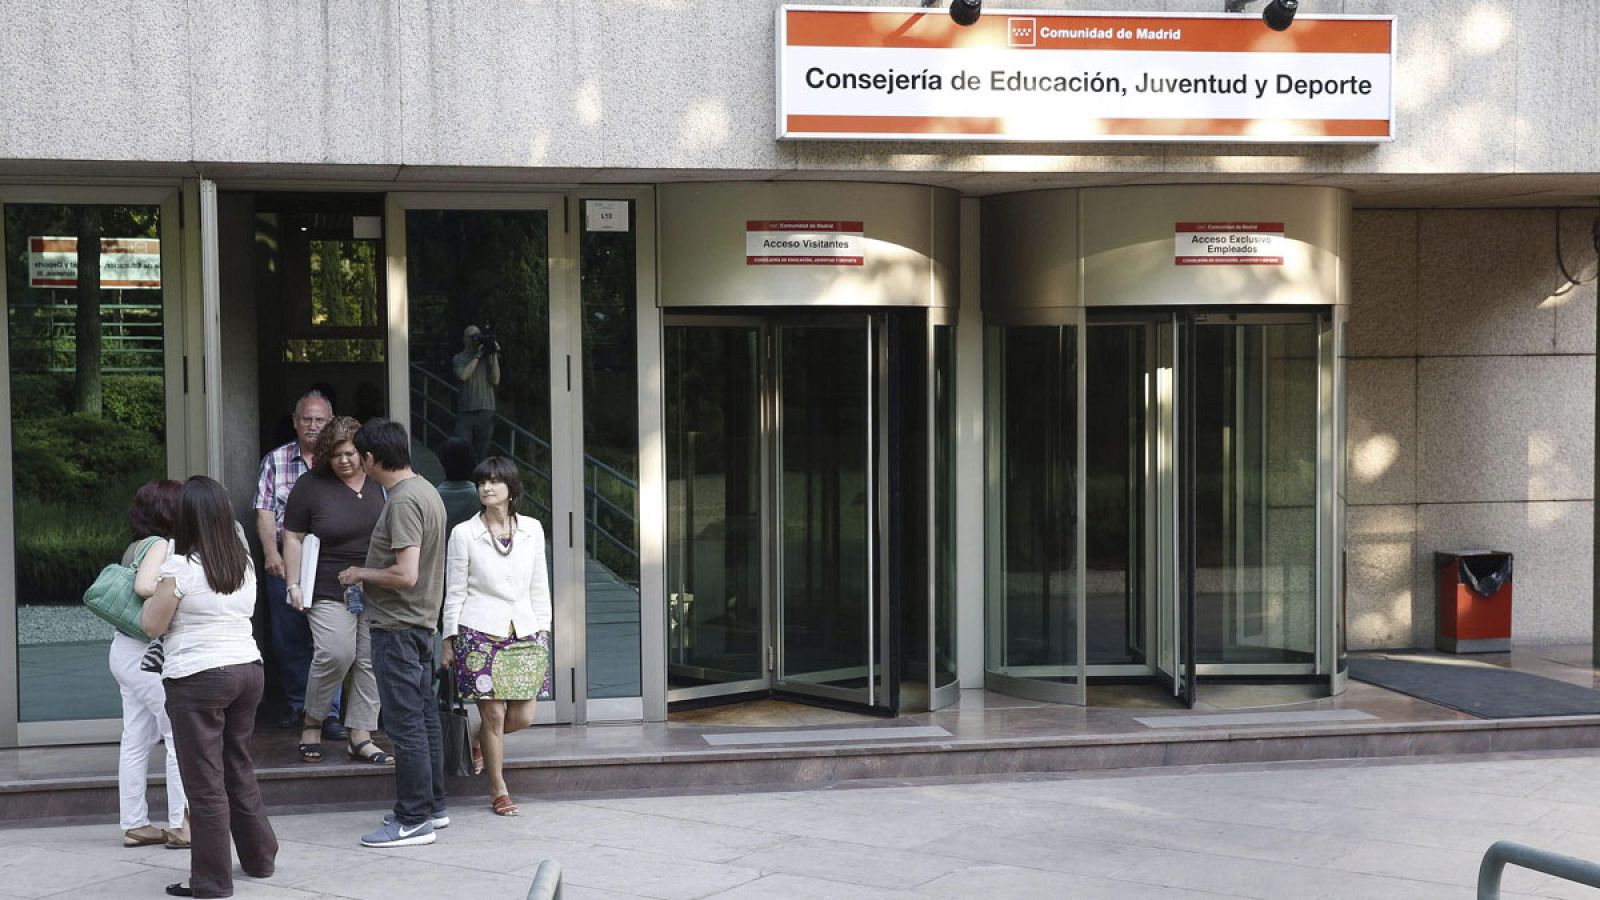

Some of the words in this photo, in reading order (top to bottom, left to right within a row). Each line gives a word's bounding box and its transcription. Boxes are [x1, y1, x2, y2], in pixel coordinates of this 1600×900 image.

[1040, 26, 1113, 39] Comunidad
[1116, 27, 1133, 39] de
[1136, 28, 1181, 40] Madrid
[805, 66, 943, 95] Consejería
[950, 70, 981, 90] de
[990, 70, 1128, 97] Educación,
[1135, 72, 1248, 94] Juventud
[1255, 78, 1268, 98] y
[1276, 74, 1373, 99] Deporte
[763, 239, 800, 249] Acceso
[802, 239, 849, 249] Visitantes
[1191, 235, 1227, 244] Acceso
[1229, 235, 1272, 244] Exclusivo
[1207, 245, 1257, 254] Empleados
